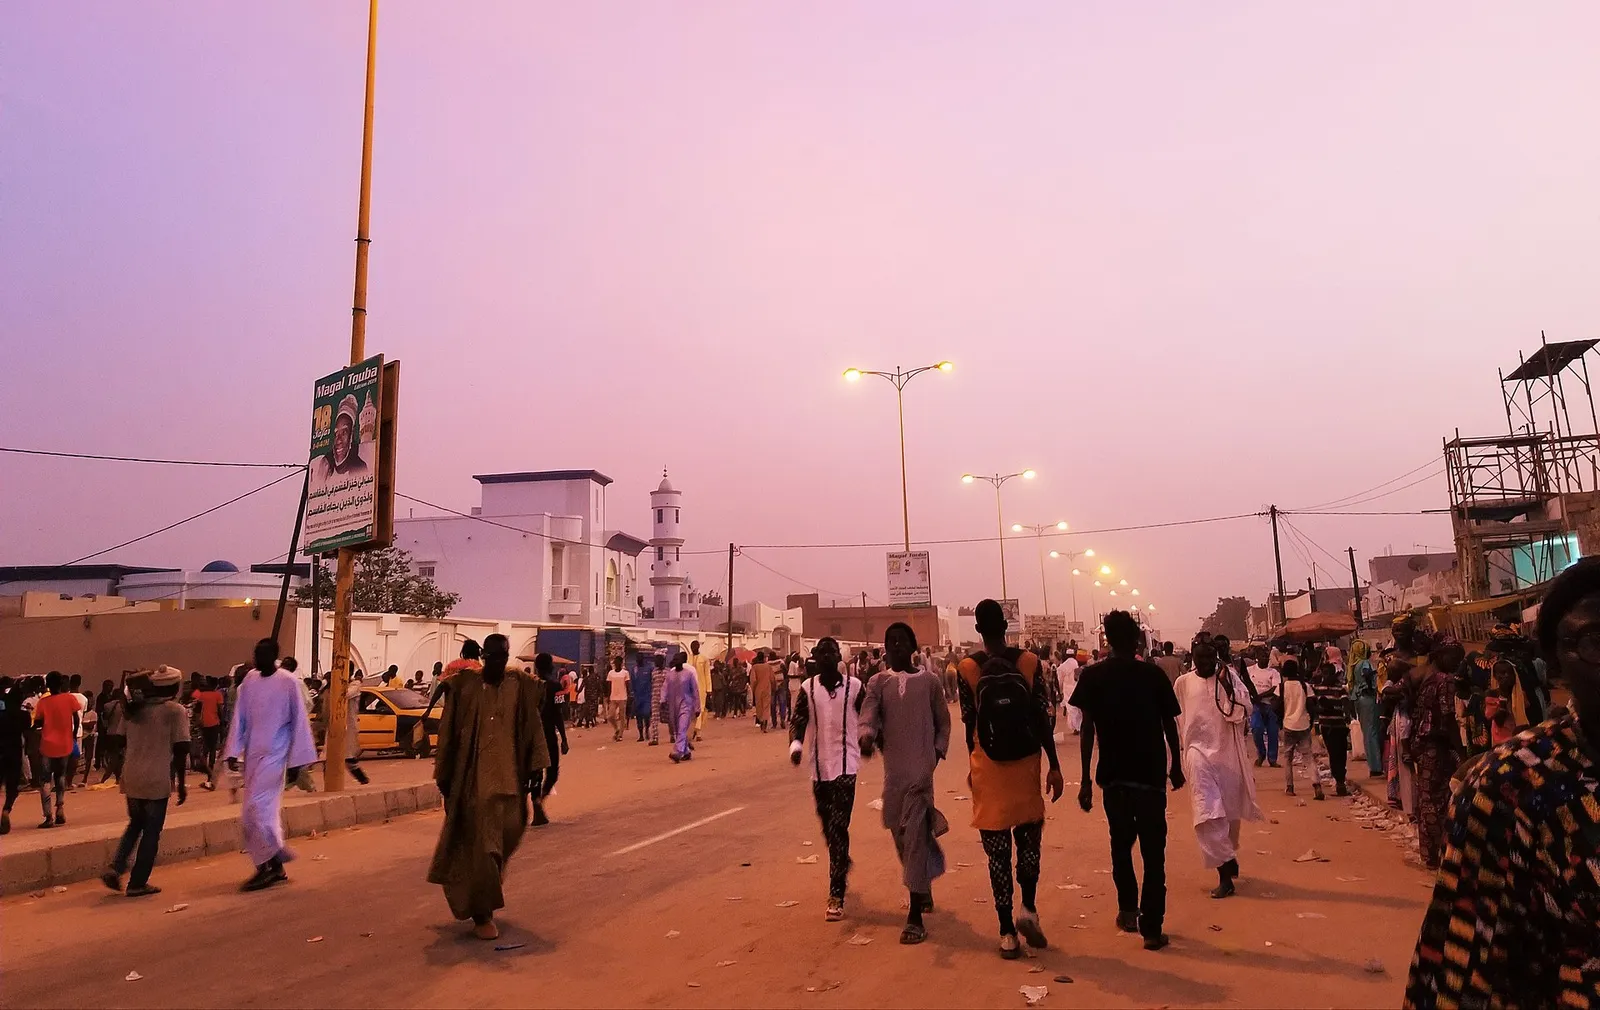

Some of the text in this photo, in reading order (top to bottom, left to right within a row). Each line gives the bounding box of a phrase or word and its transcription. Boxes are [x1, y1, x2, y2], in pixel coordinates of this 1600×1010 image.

[315, 366, 378, 399] Magal Touba
[313, 404, 332, 430] 18
